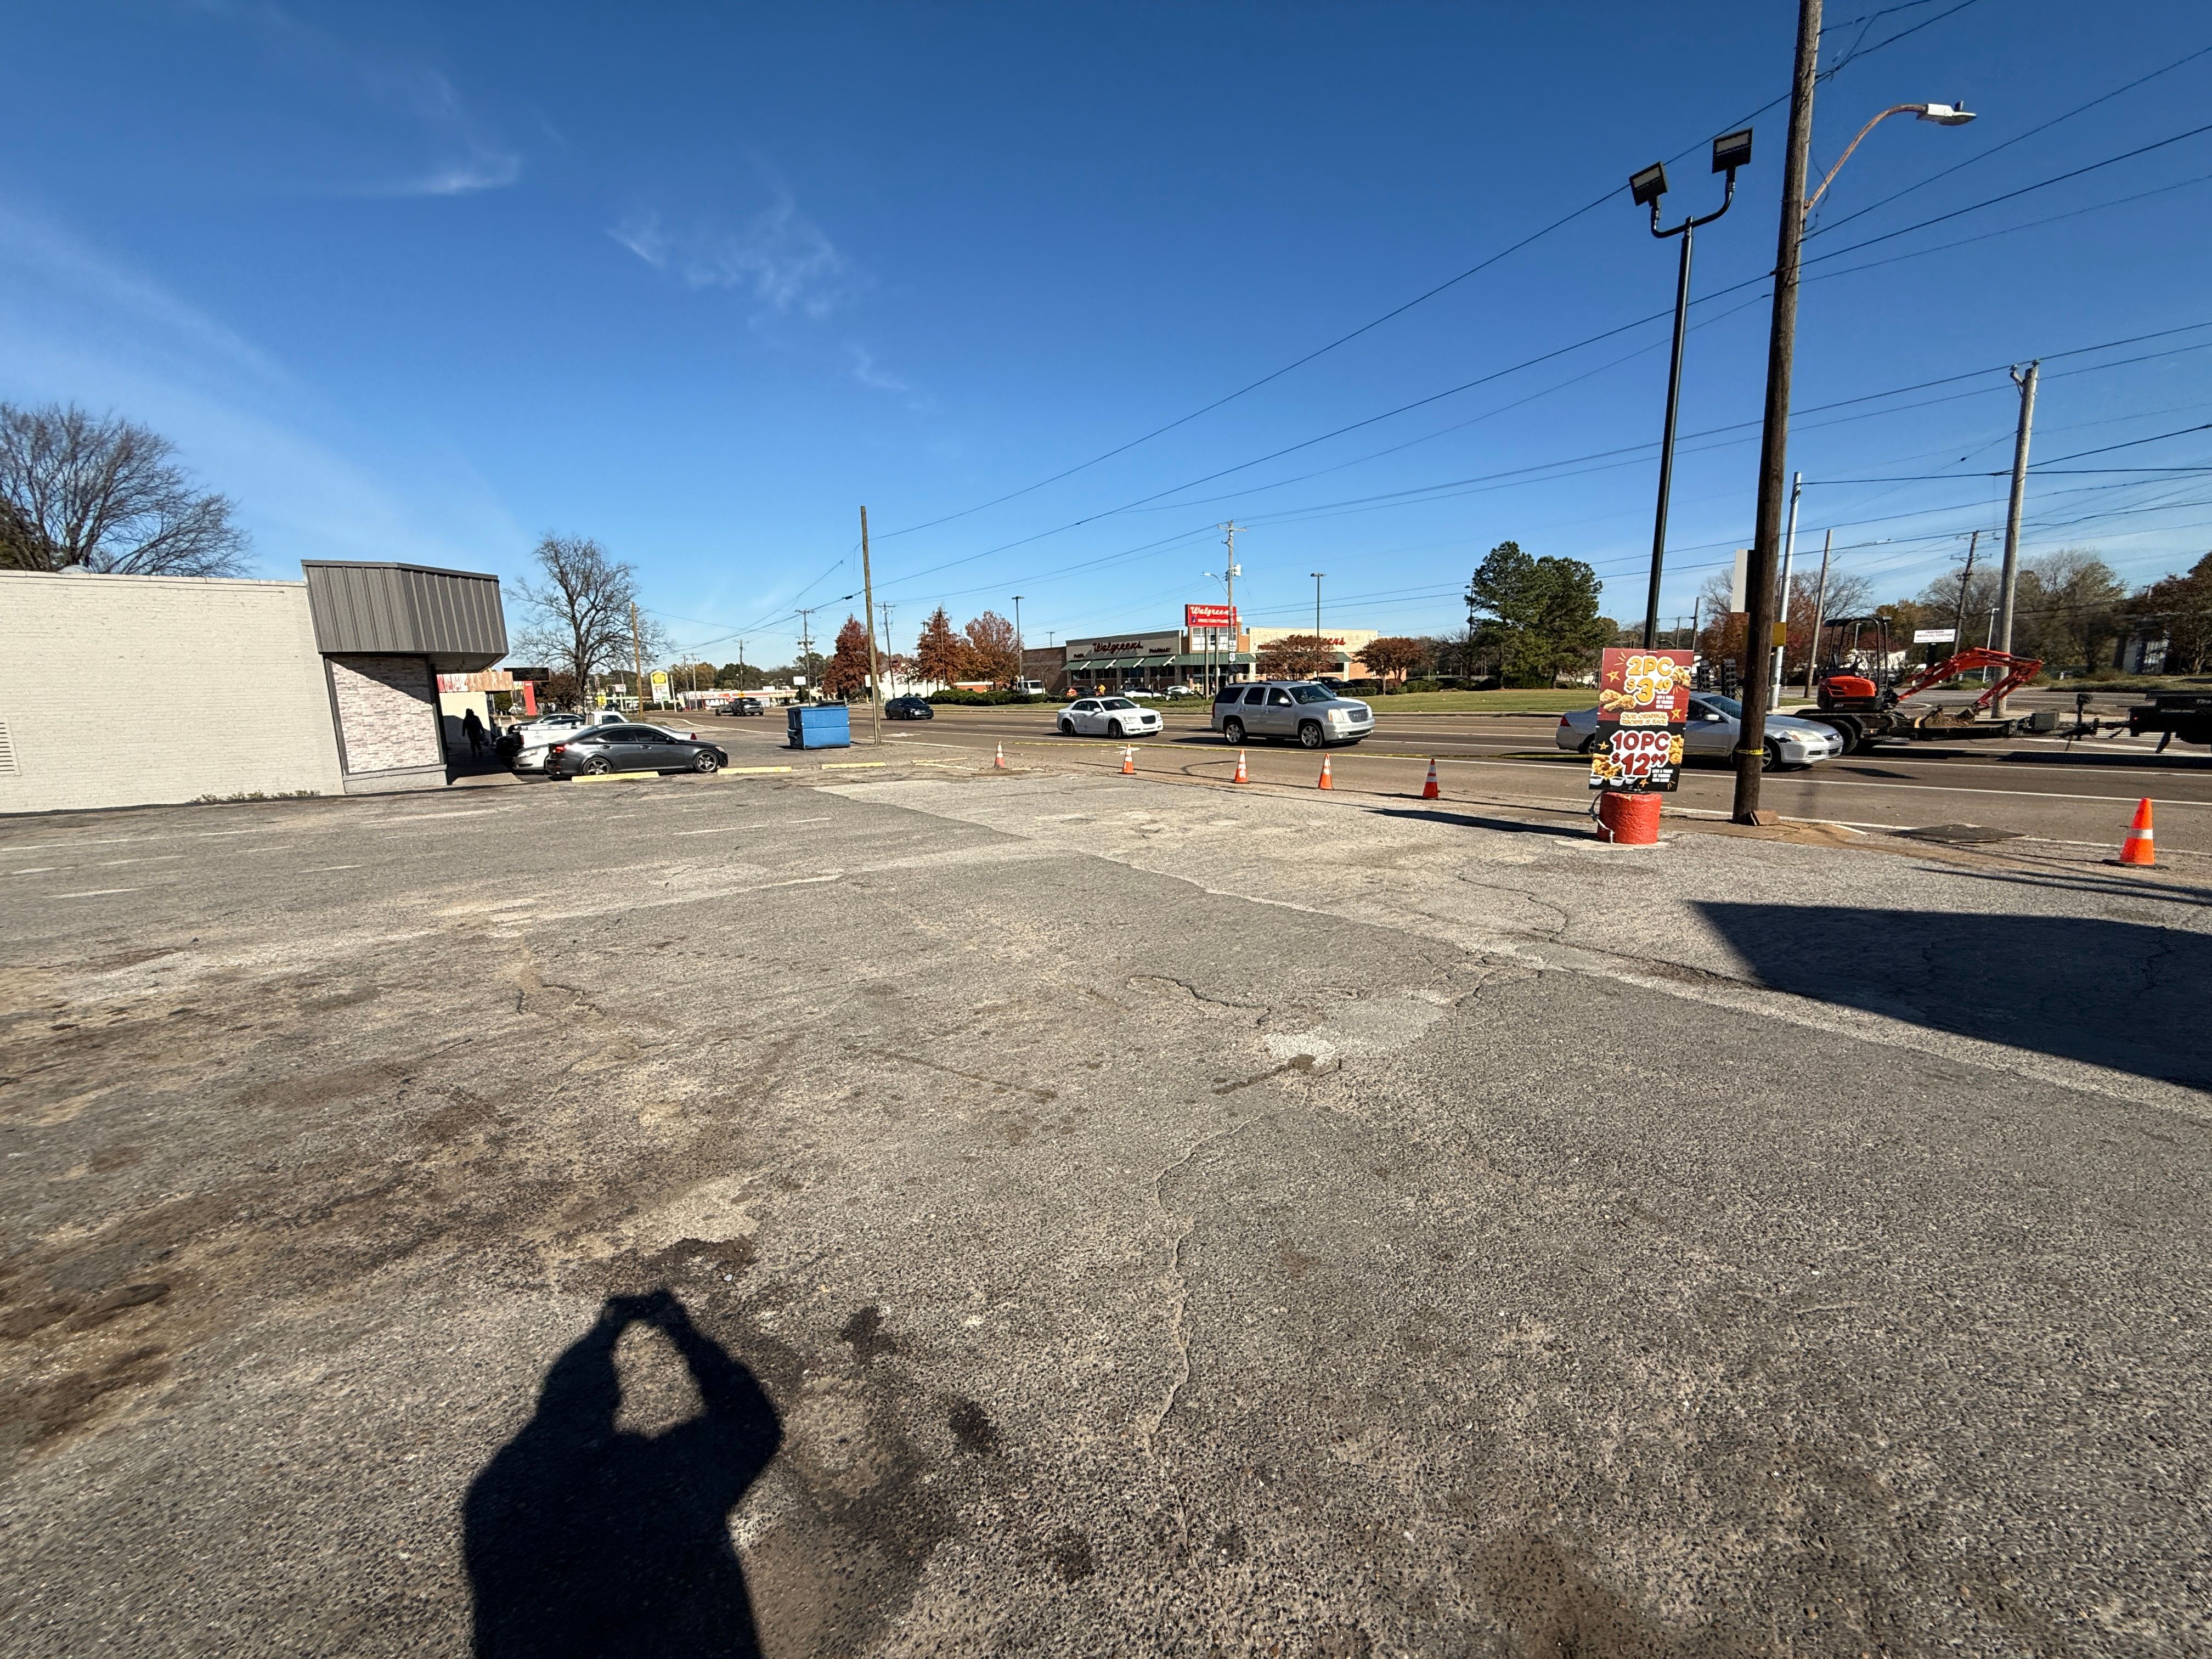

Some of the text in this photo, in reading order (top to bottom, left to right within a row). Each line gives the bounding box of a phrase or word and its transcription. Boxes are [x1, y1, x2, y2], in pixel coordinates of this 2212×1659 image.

[1190, 607, 1234, 617] Walgreen
[1093, 641, 1143, 654] Walgreens
[1628, 657, 1672, 676] 2PC
[1613, 732, 1670, 751] 10PC
